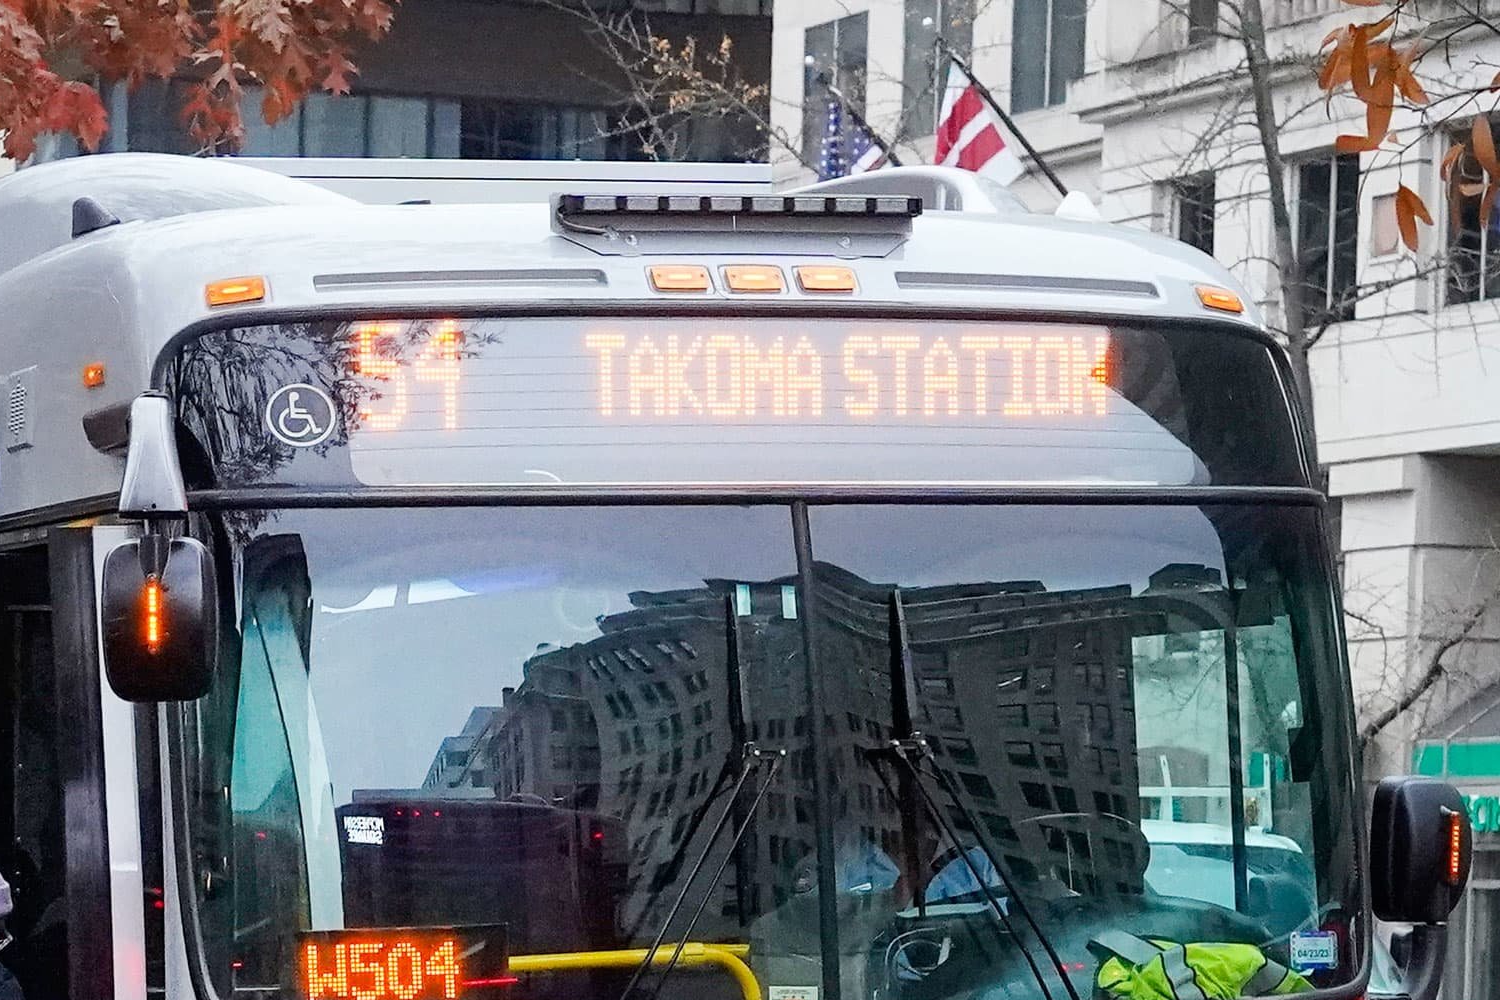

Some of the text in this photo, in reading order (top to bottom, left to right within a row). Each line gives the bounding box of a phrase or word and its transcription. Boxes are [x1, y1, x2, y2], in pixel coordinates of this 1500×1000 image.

[353, 318, 461, 430] 54
[585, 333, 1109, 417] TAKOMA STATION
